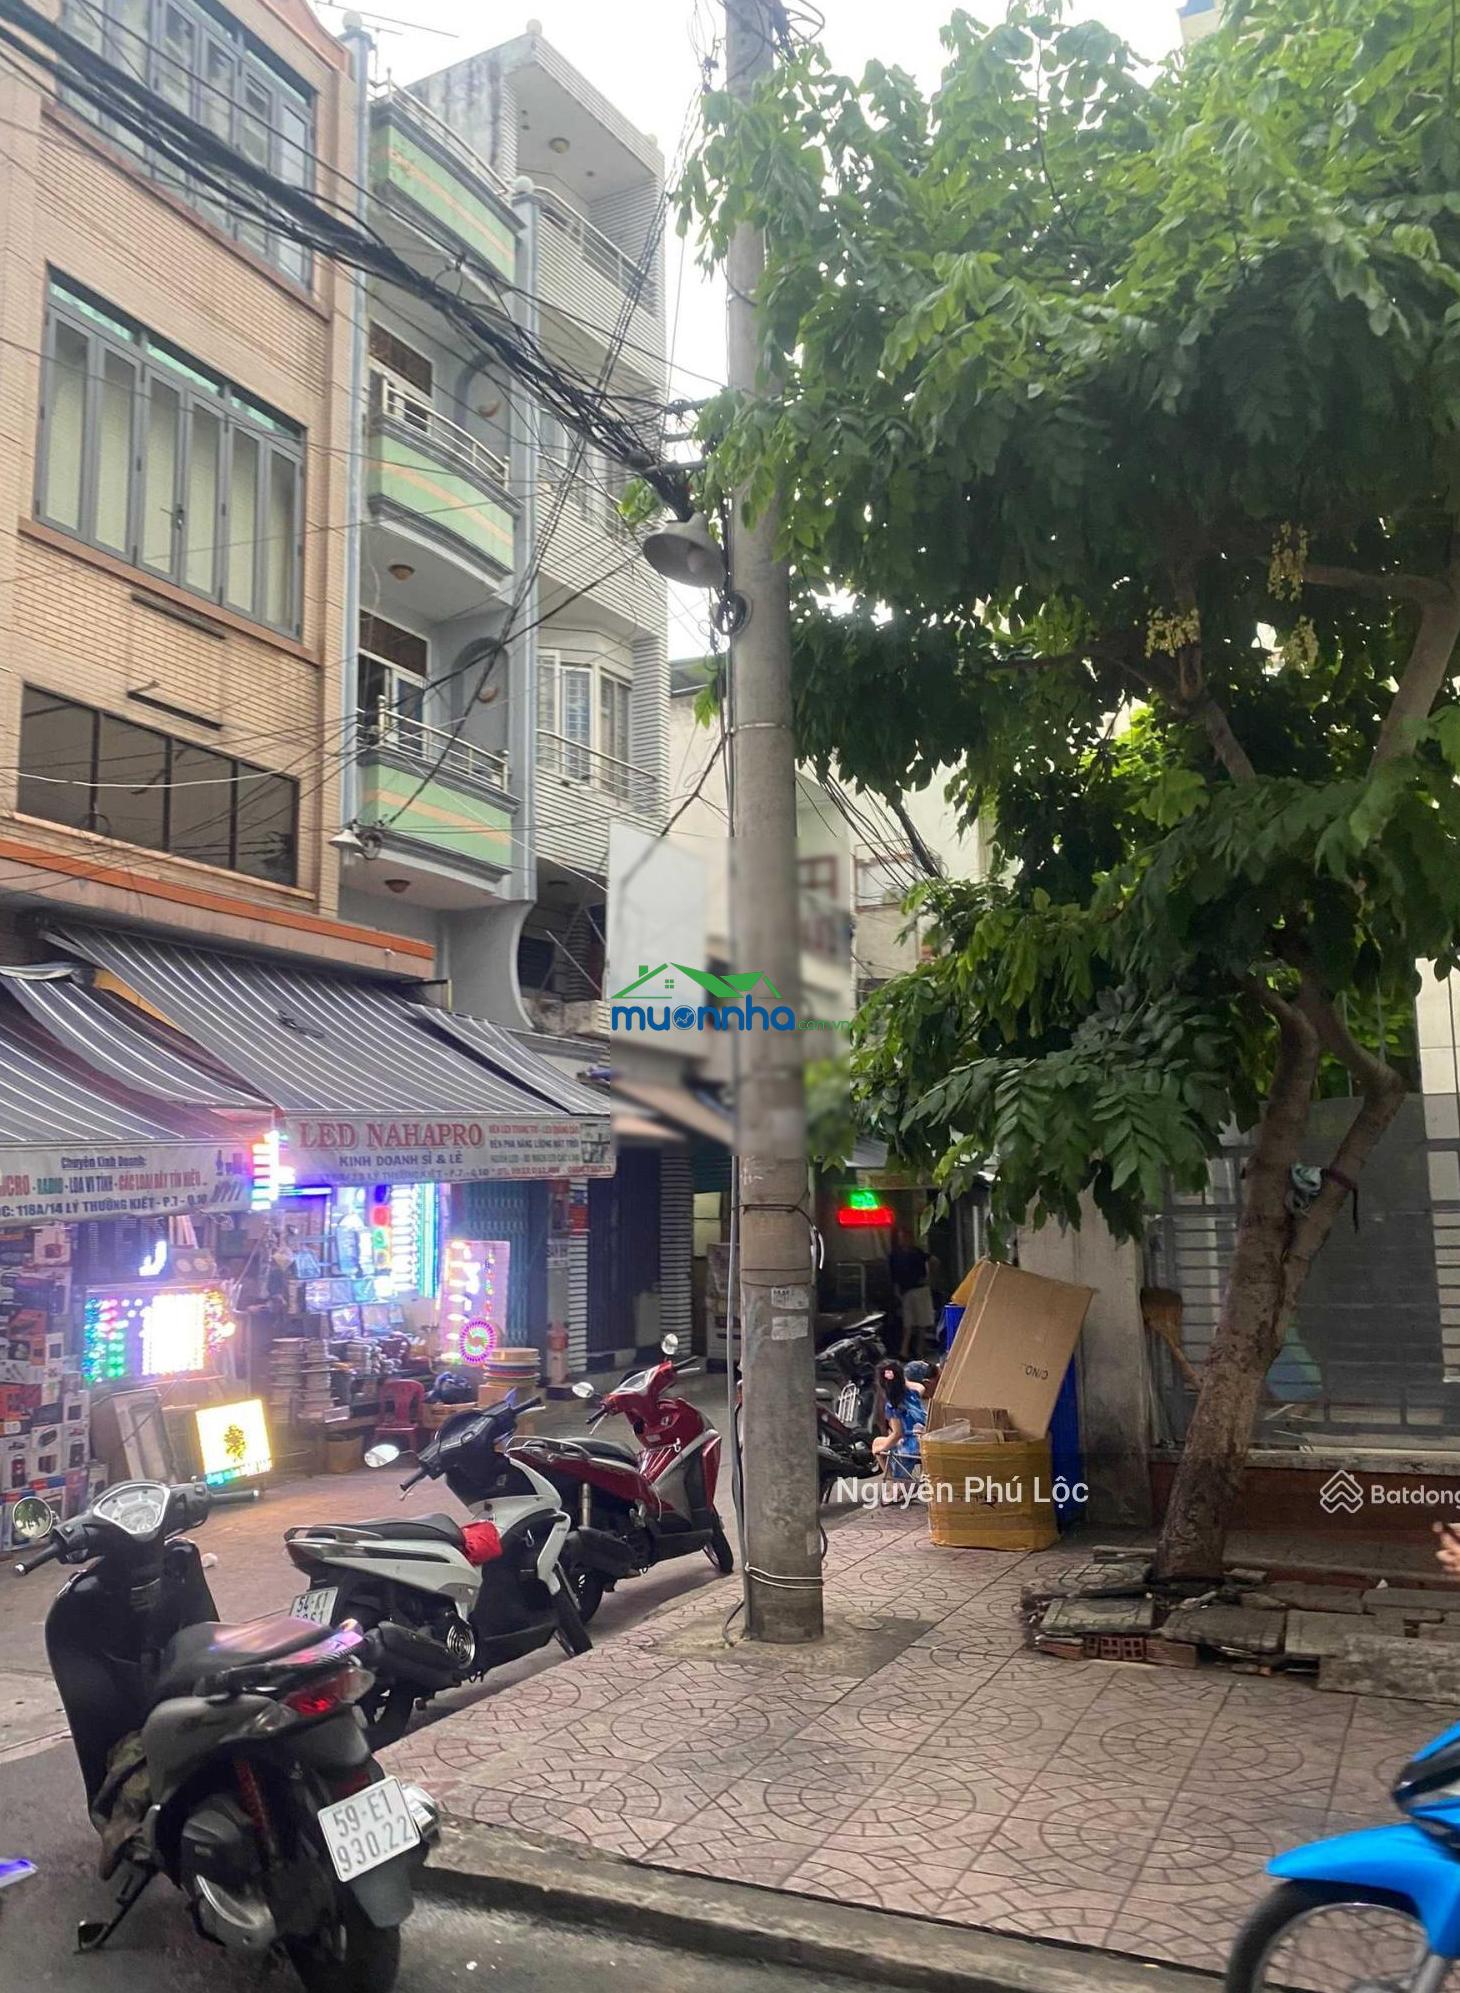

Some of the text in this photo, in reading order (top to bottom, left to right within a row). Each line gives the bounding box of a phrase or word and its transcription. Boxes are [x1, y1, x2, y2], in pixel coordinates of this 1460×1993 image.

[299, 1122, 356, 1148] LED
[366, 1121, 484, 1148] NAHAPRO
[339, 1156, 371, 1167] KINH
[376, 1154, 418, 1166] DOANH
[436, 1154, 446, 1164] &
[69, 1176, 84, 1194] LOA
[85, 1176, 94, 1192] VI
[16, 1202, 63, 1217] 118A/14
[66, 1198, 79, 1214] LÝ
[163, 1196, 178, 1208] P.7
[333, 1789, 392, 1837] 59-E1
[336, 1815, 413, 1873] 930.22
